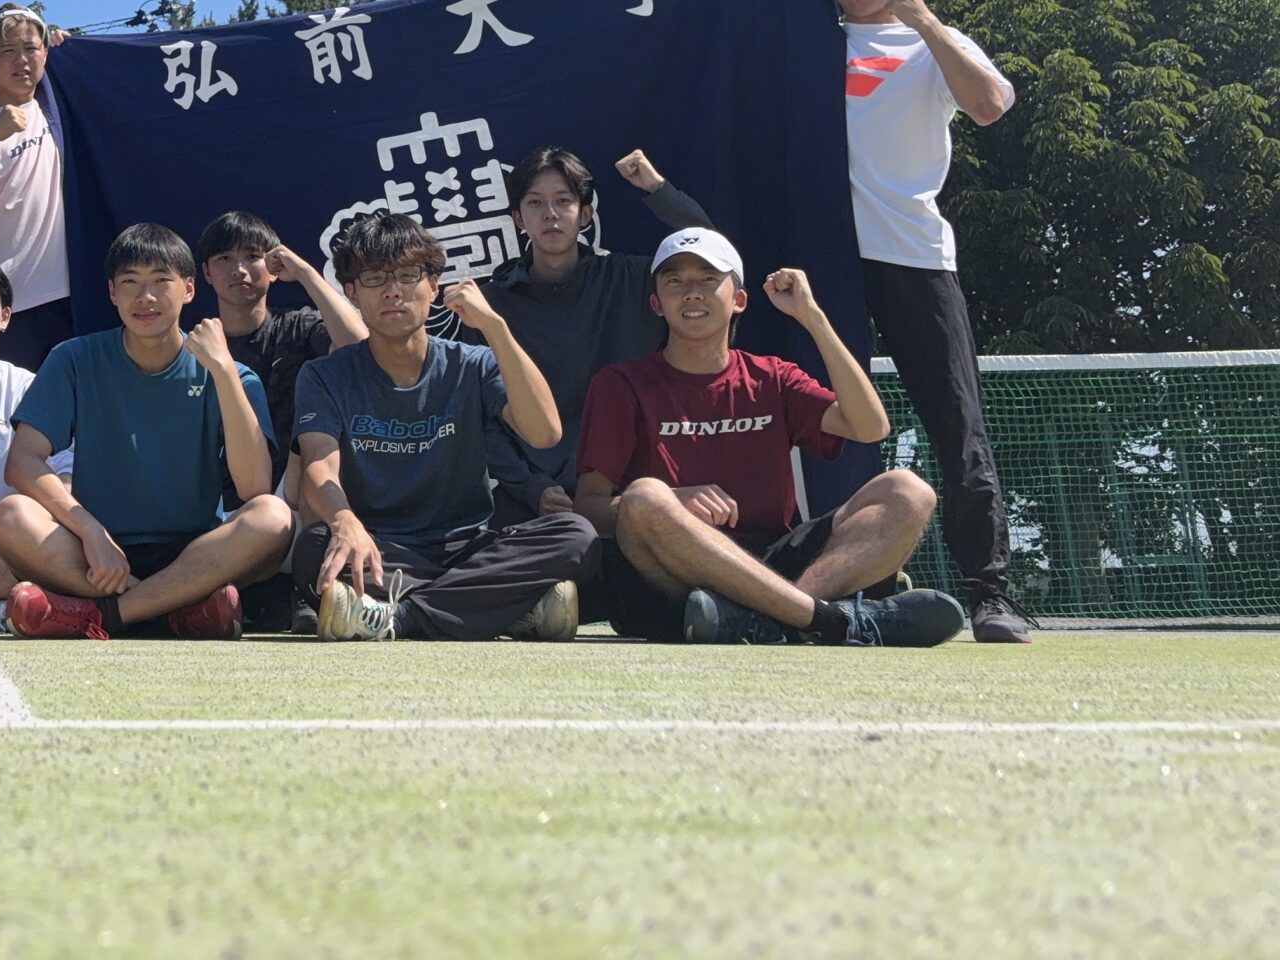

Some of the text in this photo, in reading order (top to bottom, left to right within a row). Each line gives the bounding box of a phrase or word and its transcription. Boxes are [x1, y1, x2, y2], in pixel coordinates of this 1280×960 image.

[350, 414, 451, 439] Babol
[351, 422, 456, 454] EXPLOSIVE POER
[659, 415, 773, 436] DUNLOP
